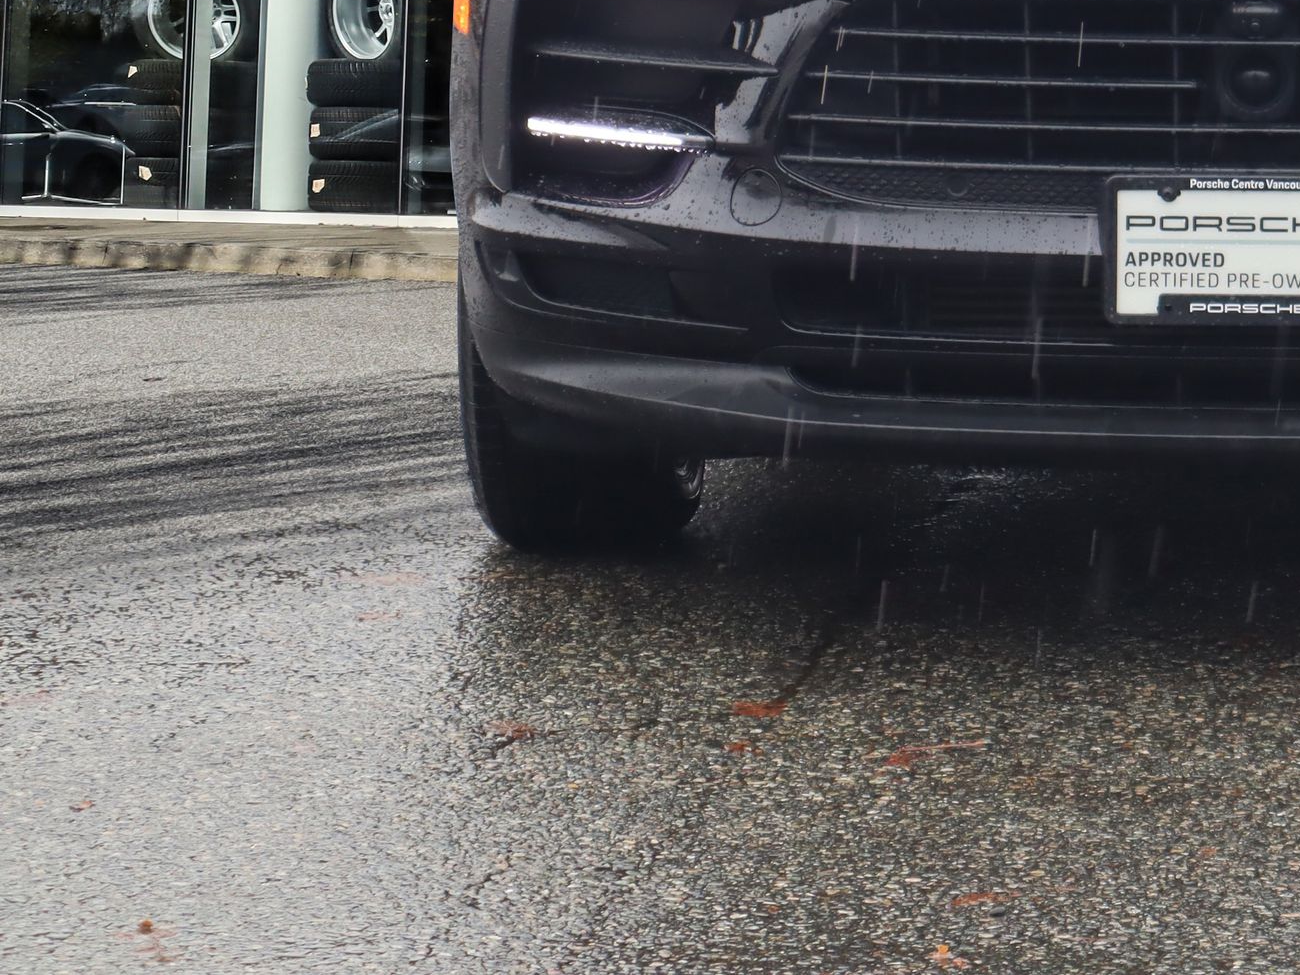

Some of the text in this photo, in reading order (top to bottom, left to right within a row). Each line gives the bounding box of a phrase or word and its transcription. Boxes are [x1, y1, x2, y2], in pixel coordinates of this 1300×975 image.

[1189, 178, 1230, 189] Porsche
[1231, 178, 1264, 189] Centre
[1125, 252, 1225, 268] APPROVED
[1124, 271, 1219, 289] CERTIFIED
